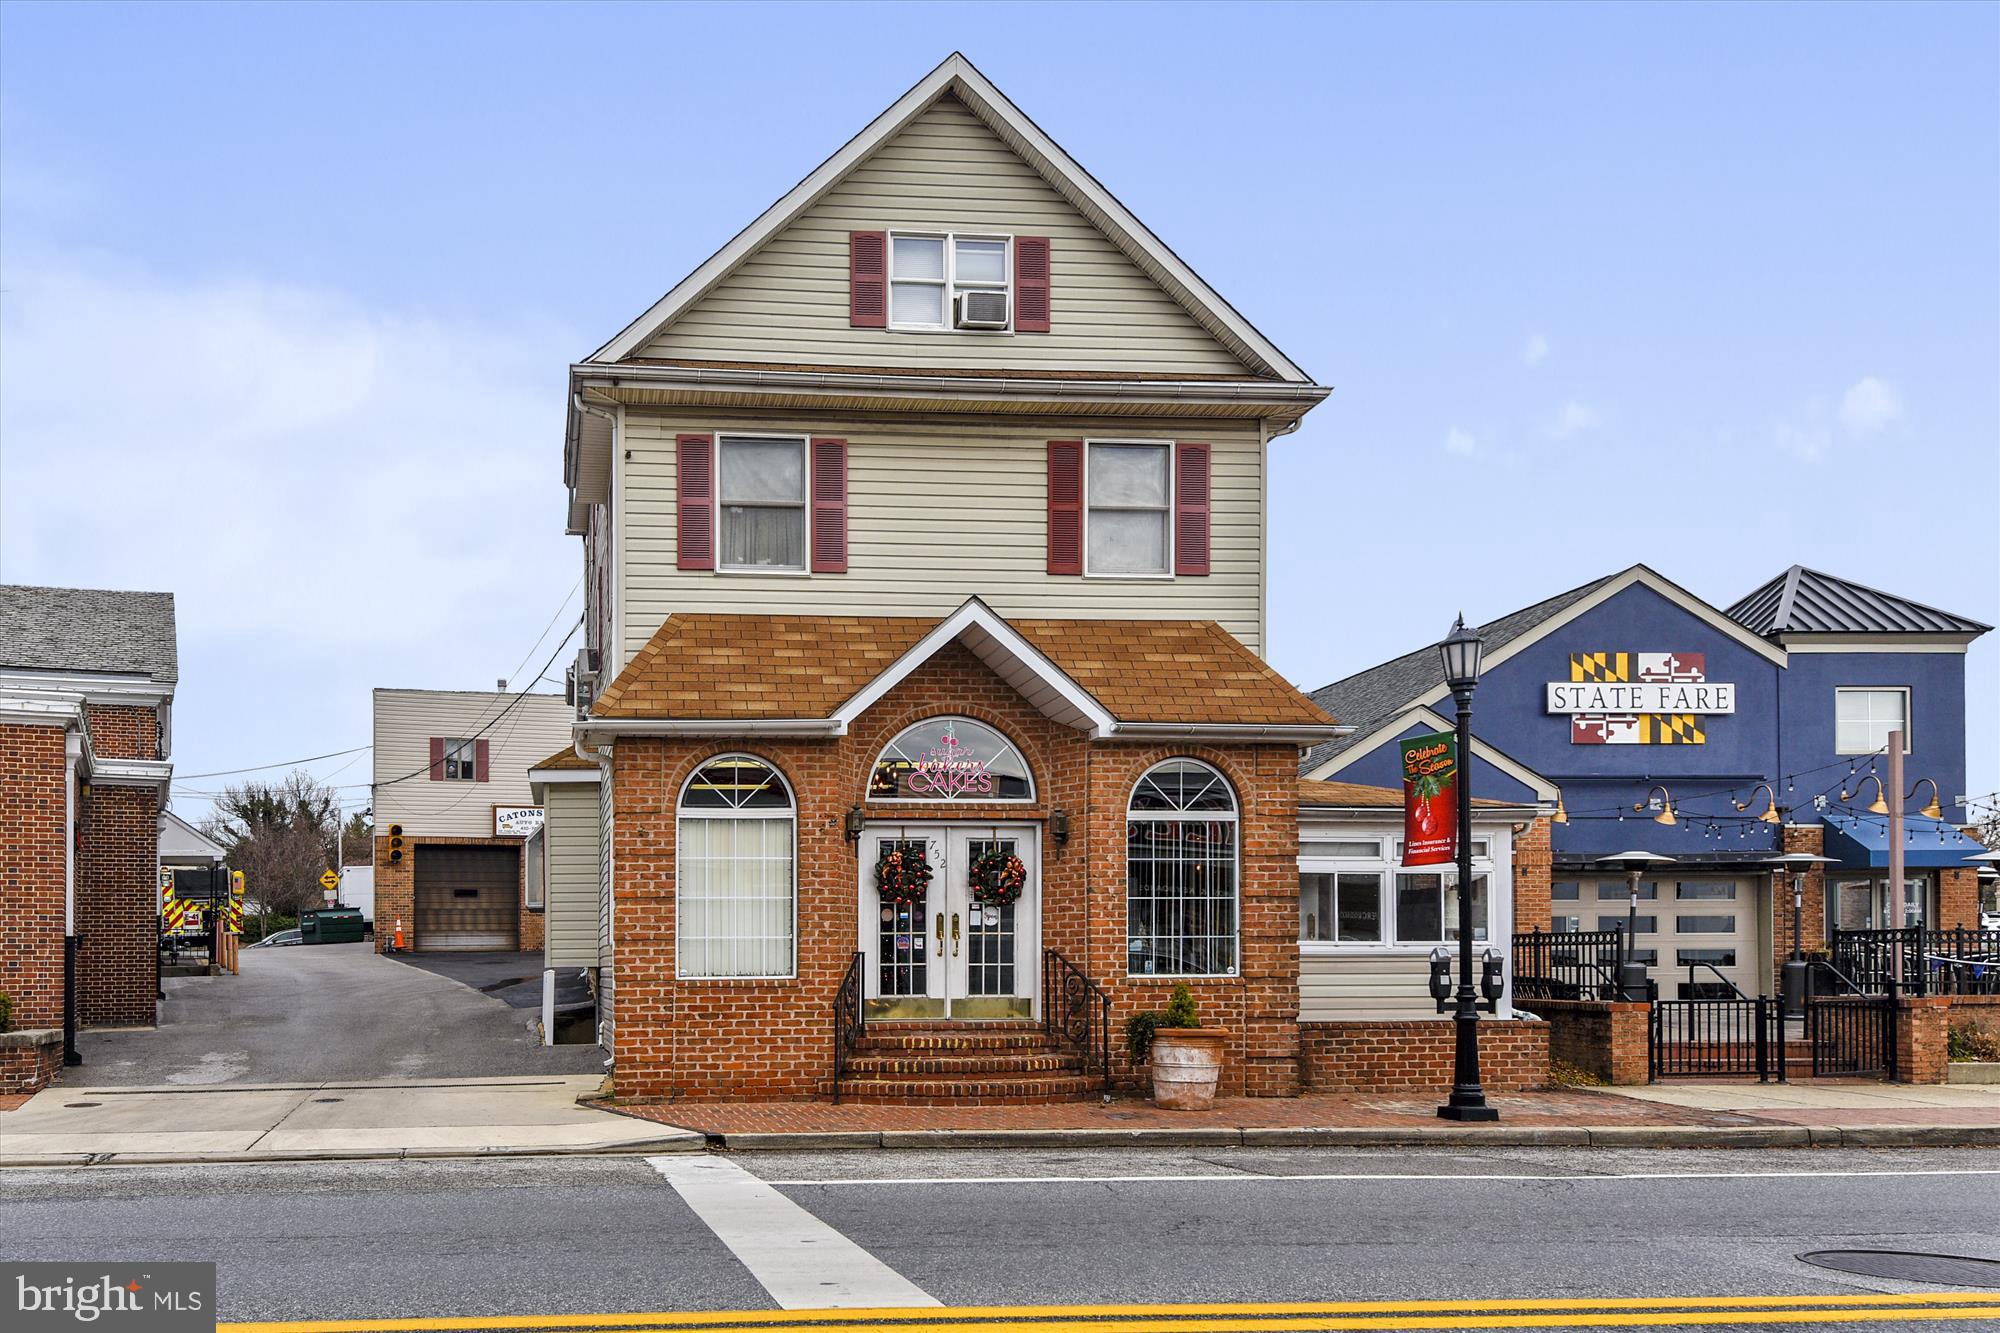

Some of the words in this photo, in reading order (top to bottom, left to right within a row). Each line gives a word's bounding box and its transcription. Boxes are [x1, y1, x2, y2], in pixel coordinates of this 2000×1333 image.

[1554, 686, 1644, 709] STATE
[1658, 687, 1729, 710] FARE
[919, 752, 985, 772] bakers
[929, 746, 975, 763] sugar
[1404, 743, 1448, 764] Celebrate
[1406, 764, 1418, 774] The
[1419, 758, 1454, 776] Season
[908, 771, 992, 793] CAKES
[498, 809, 543, 822] CATONS
[929, 840, 947, 869] 752
[1408, 846, 1431, 854] Financial
